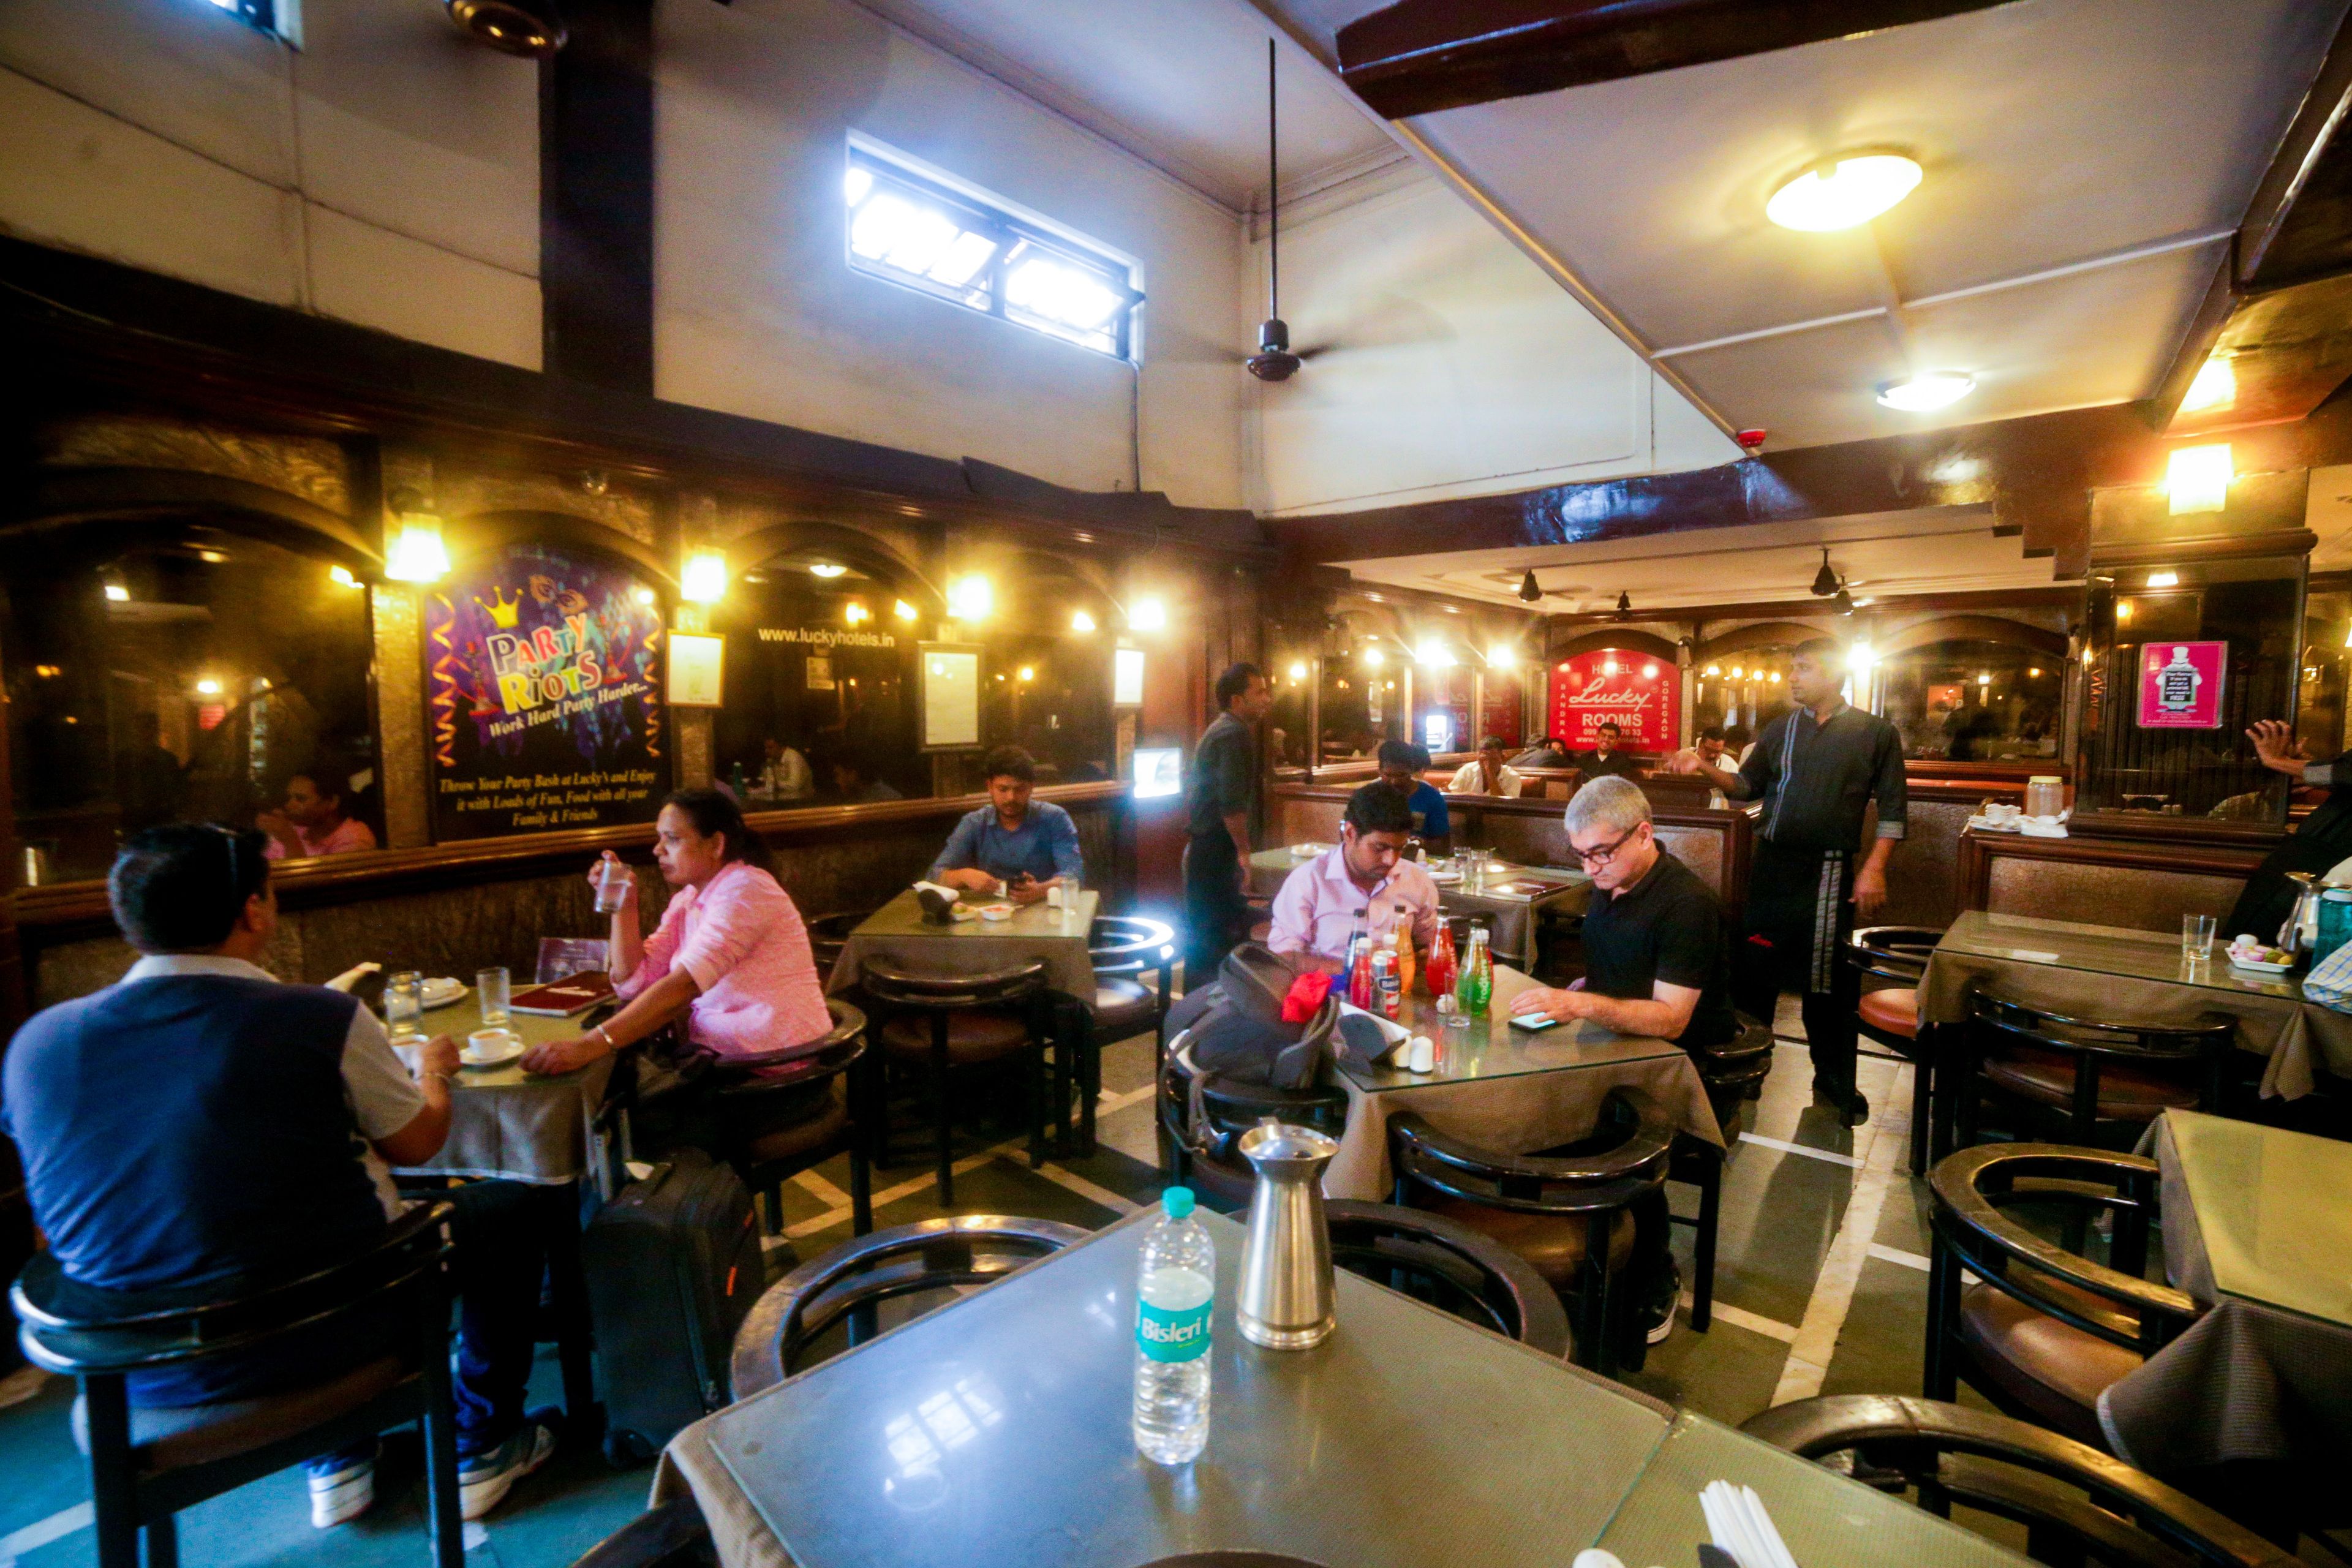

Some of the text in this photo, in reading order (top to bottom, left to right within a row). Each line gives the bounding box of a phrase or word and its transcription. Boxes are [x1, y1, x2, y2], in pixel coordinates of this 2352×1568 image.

[758, 627, 895, 648] www.luckyhotels.in
[1592, 664, 1632, 674] HEL
[1569, 677, 1651, 712] Lucky
[489, 682, 649, 737] Work Hard Party Harder...
[1582, 713, 1643, 726] ROOMS
[1661, 680, 1670, 739] GOREGAON
[440, 778, 475, 793] Throw
[505, 775, 532, 791] Party
[561, 776, 571, 785] at
[573, 772, 608, 786] Lucky's
[611, 770, 628, 782] and
[630, 769, 656, 784] Enjoy
[467, 796, 491, 810] with
[494, 794, 524, 809] Loads
[526, 794, 539, 809] of
[566, 790, 591, 803] Food
[592, 788, 612, 801] with
[614, 788, 627, 800] all
[512, 807, 598, 827] Family & Friends
[1142, 1316, 1201, 1343] Bisleri
